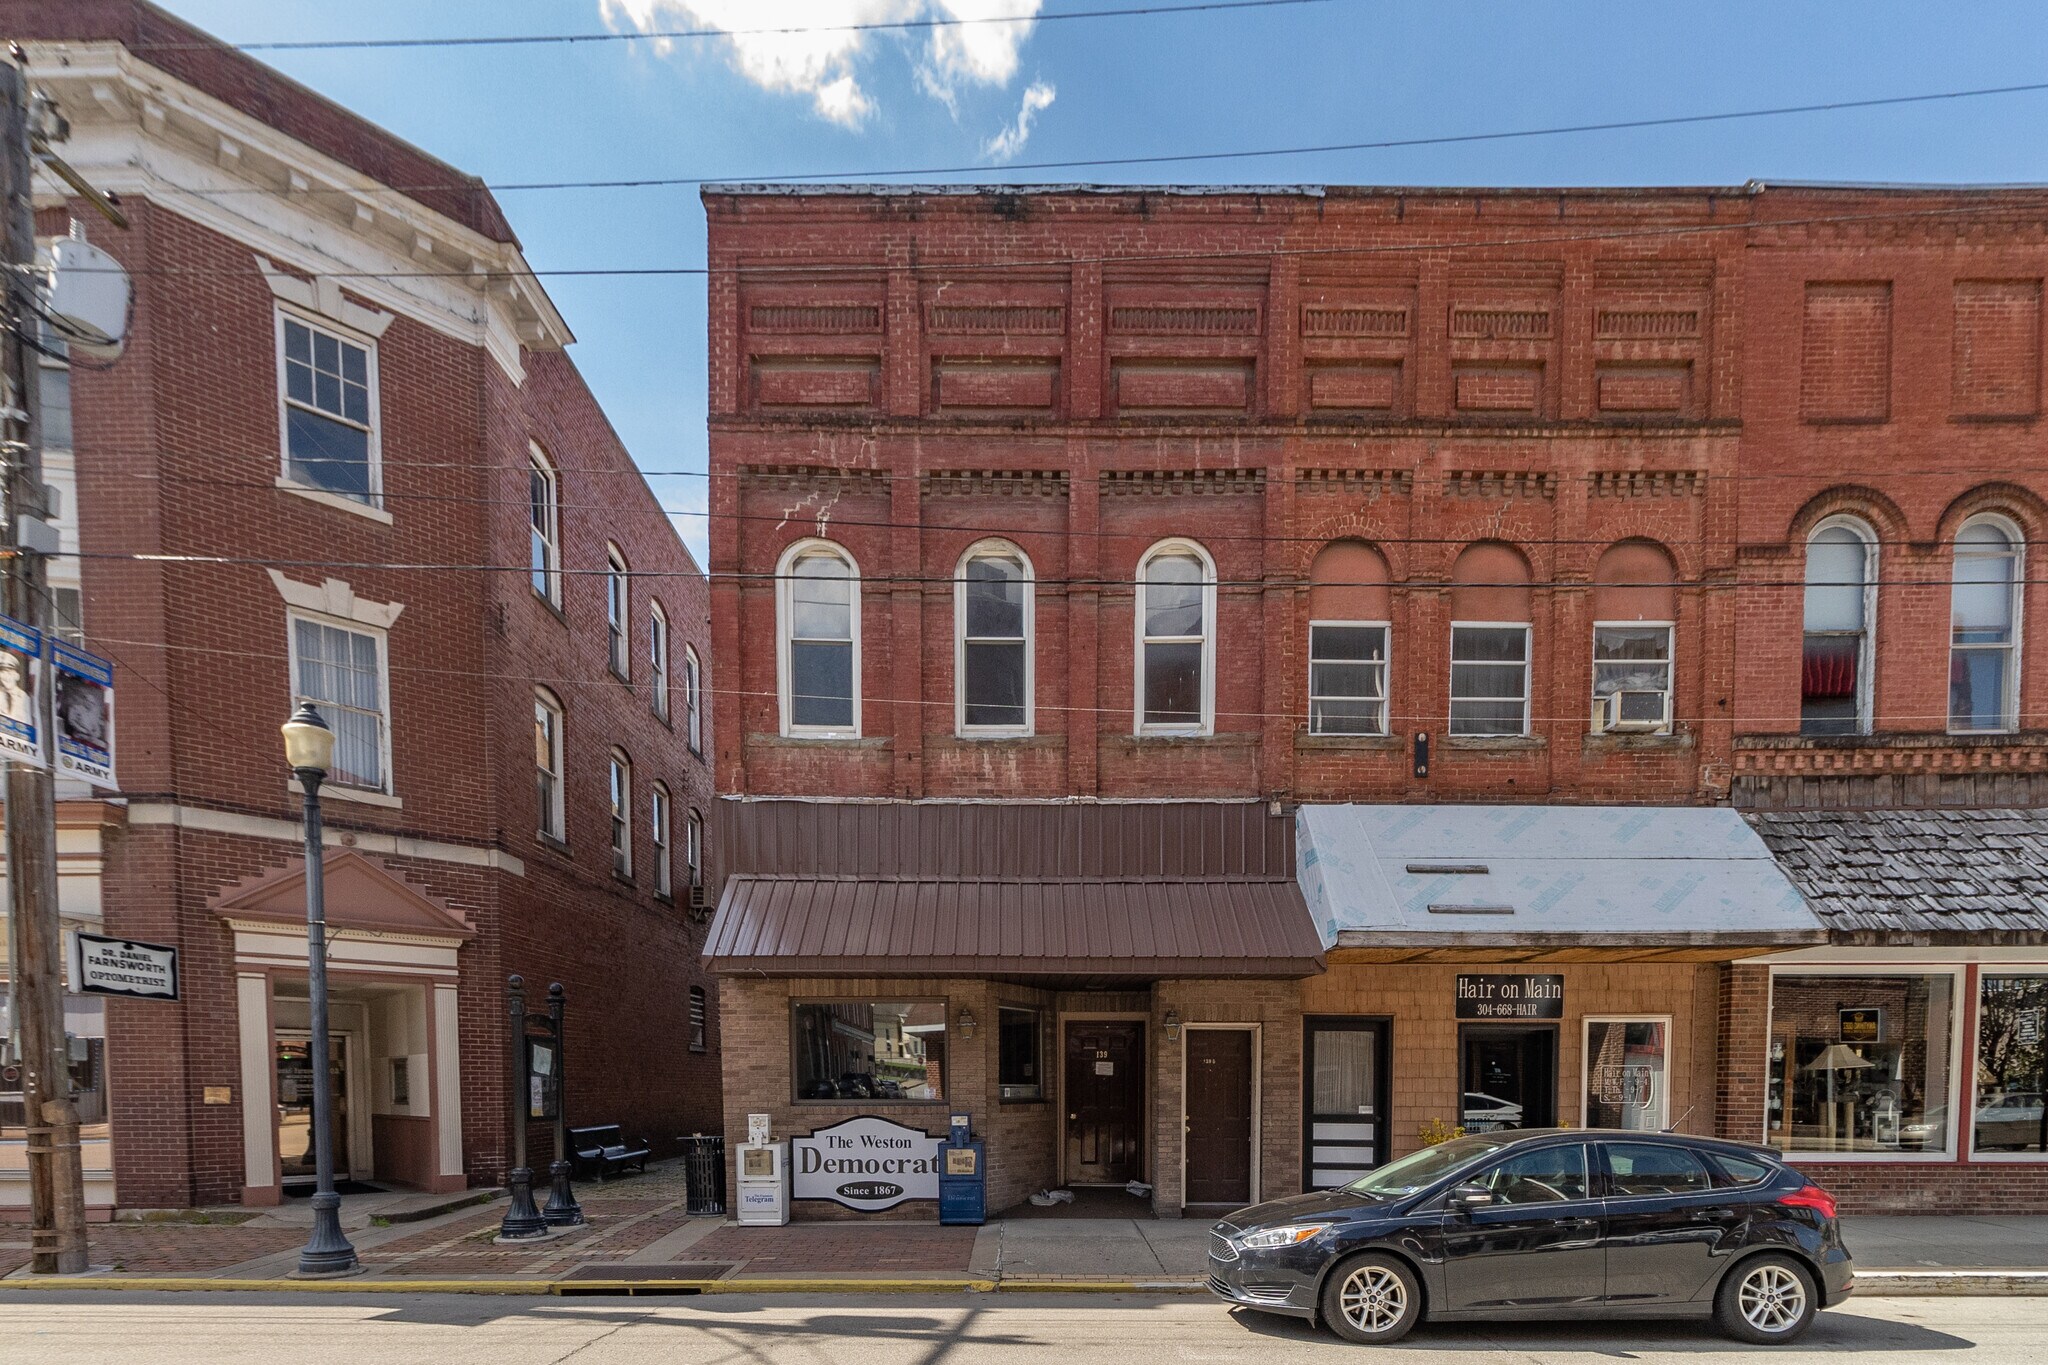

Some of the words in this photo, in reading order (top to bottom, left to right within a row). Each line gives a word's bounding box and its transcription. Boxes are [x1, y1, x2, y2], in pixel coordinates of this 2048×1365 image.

[75, 762, 109, 780] ARMY
[102, 948, 117, 957] DR.
[119, 951, 152, 962] DANIEL
[88, 956, 166, 974] FARNSWORTH
[90, 971, 166, 987] OPTOMETRIST
[1459, 978, 1495, 998] Hair
[1501, 984, 1519, 998] on
[1524, 978, 1561, 998] Main
[1477, 1003, 1537, 1015] 304-668-HAIR
[1603, 1067, 1621, 1078] Hair
[1632, 1067, 1649, 1078] Main
[826, 1135, 853, 1149] The
[860, 1135, 912, 1149] Weston
[799, 1146, 940, 1174] Democrat
[843, 1186, 870, 1195] Since
[874, 1186, 896, 1195] 1867
[745, 1195, 774, 1204] Telegram
